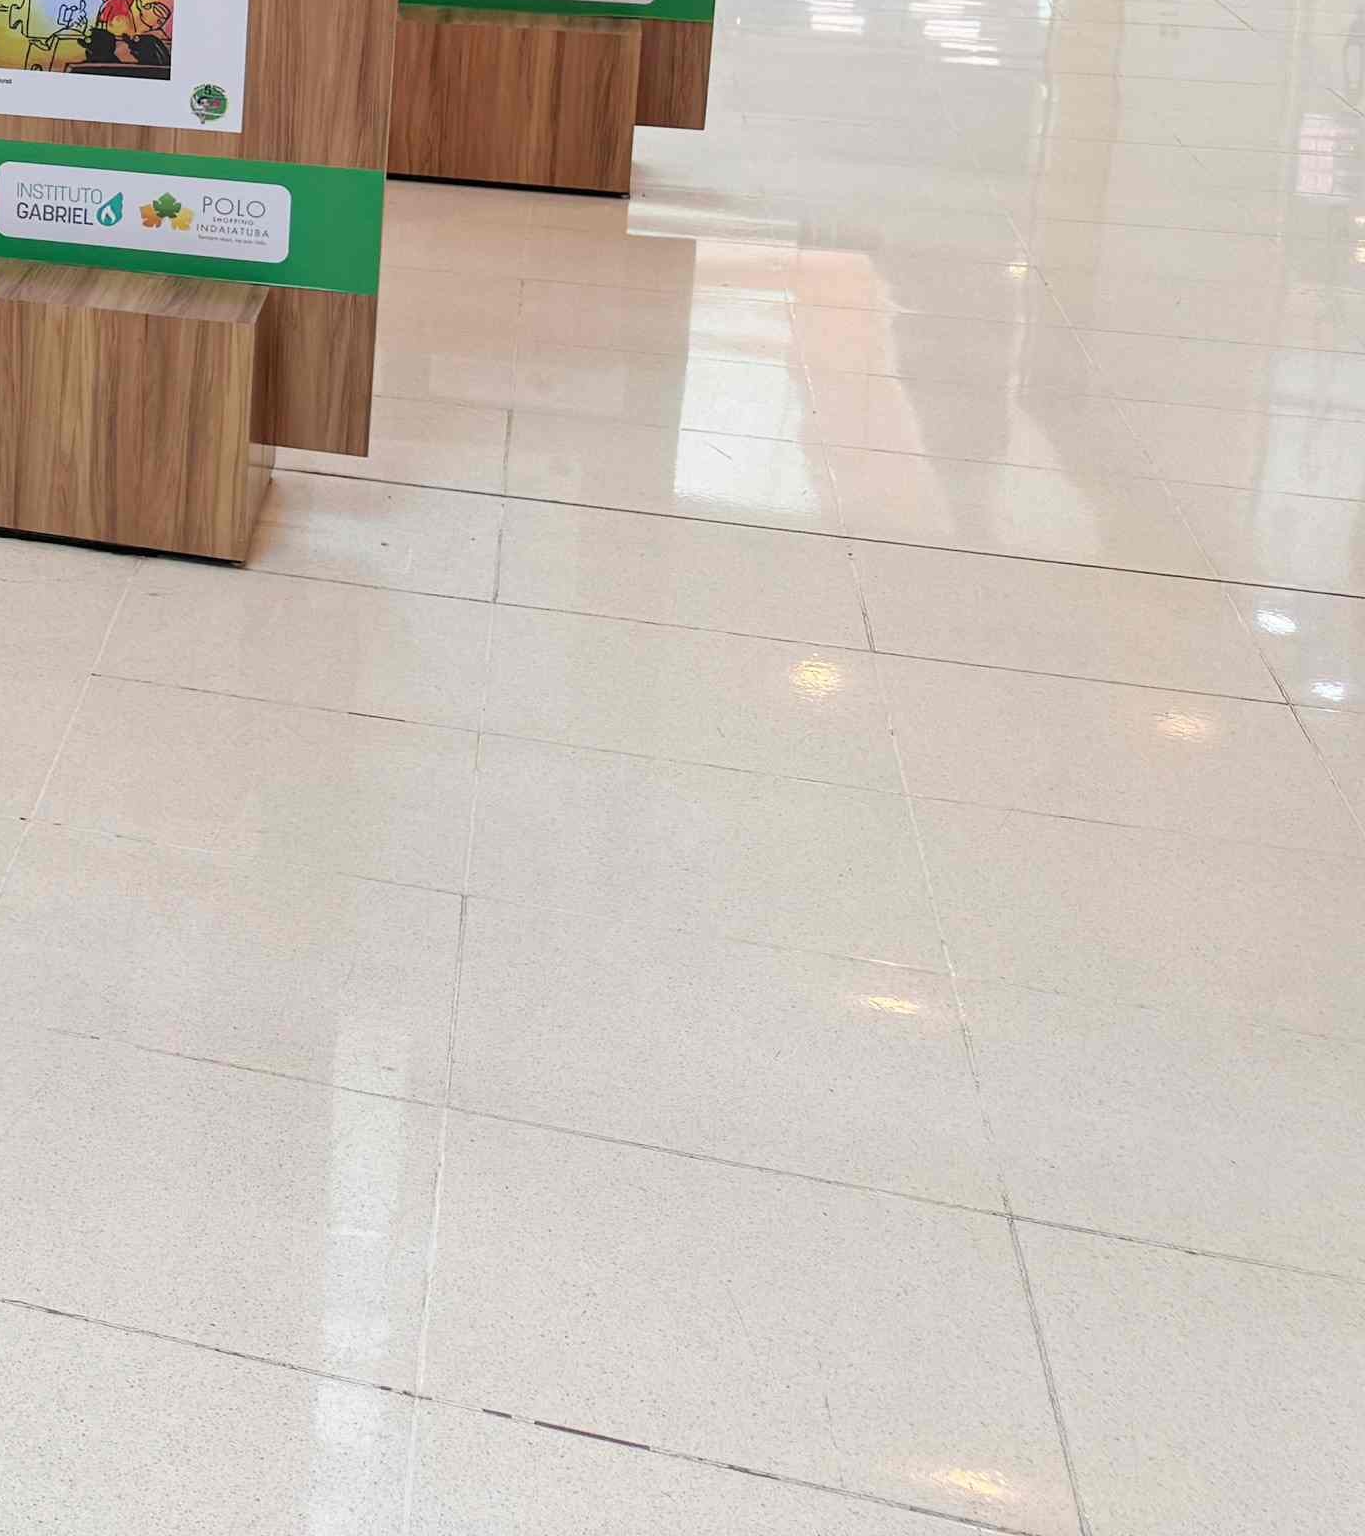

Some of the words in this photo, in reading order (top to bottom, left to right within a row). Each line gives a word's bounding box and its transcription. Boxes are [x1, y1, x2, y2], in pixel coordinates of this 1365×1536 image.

[17, 182, 103, 204] INSTITUTO
[202, 196, 266, 218] POLO
[17, 202, 93, 226] GABRIEL
[197, 223, 270, 238] INDAIATUBA
